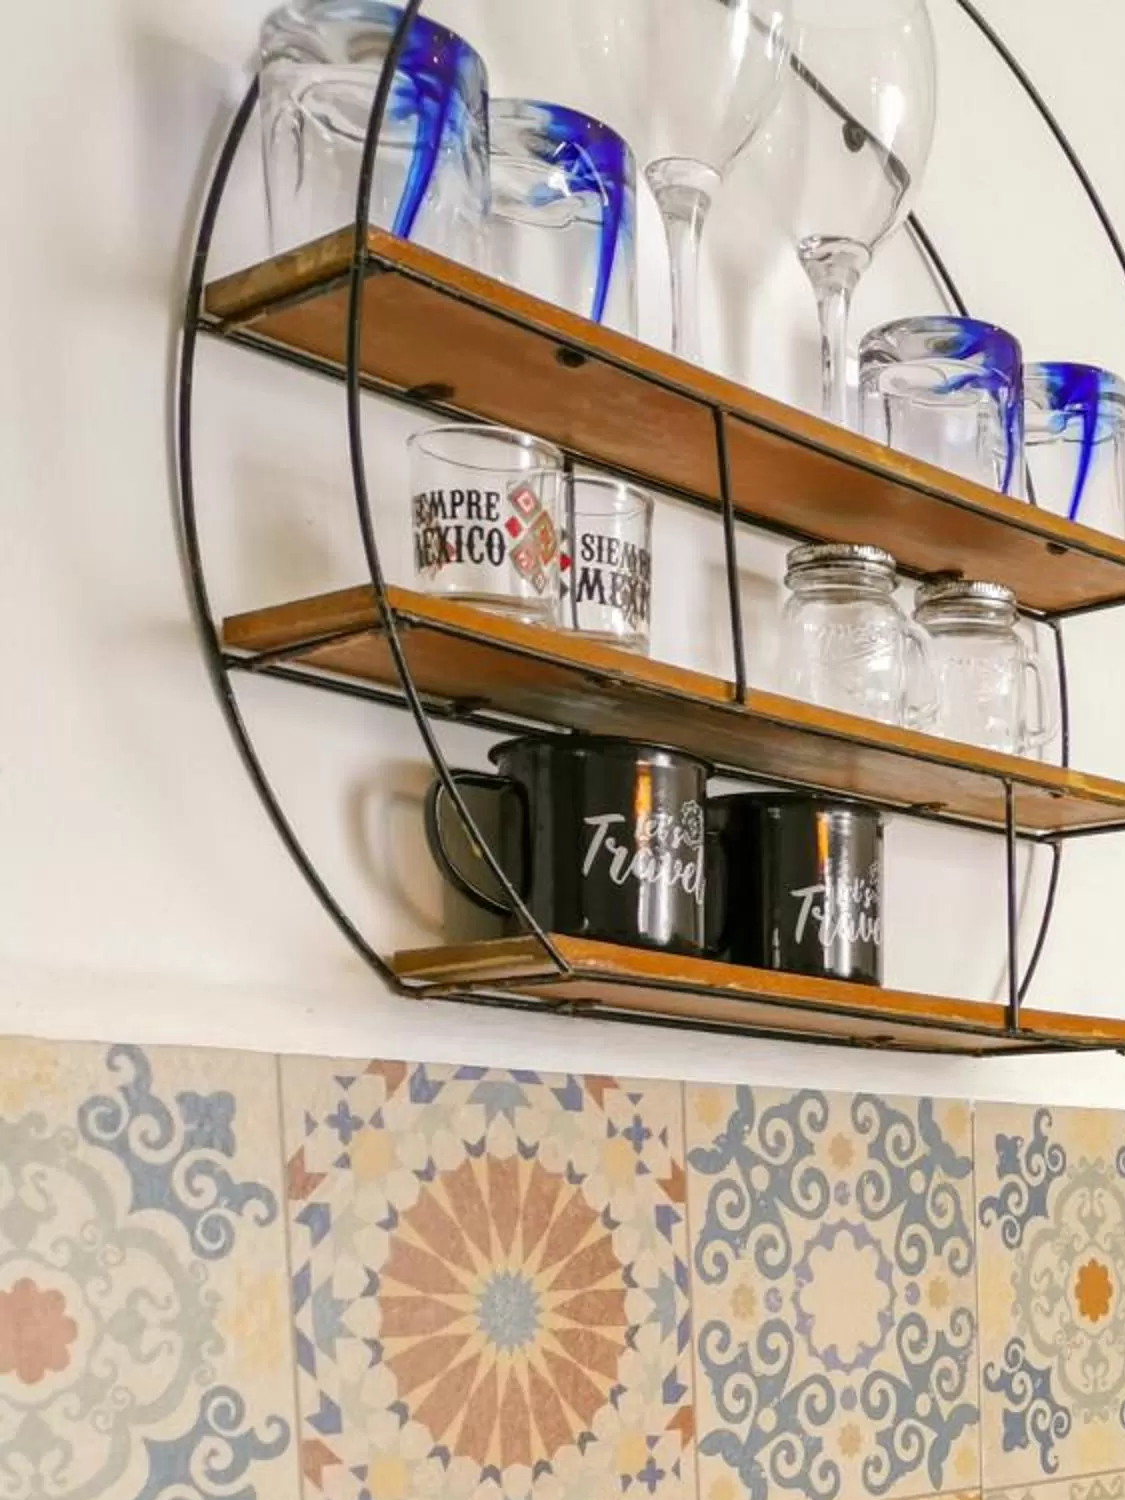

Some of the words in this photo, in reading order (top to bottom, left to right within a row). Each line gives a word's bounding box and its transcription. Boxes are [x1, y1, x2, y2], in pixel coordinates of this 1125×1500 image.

[413, 488, 500, 527] EMPRE
[583, 813, 705, 905] Travel
[790, 884, 881, 947] Trave
